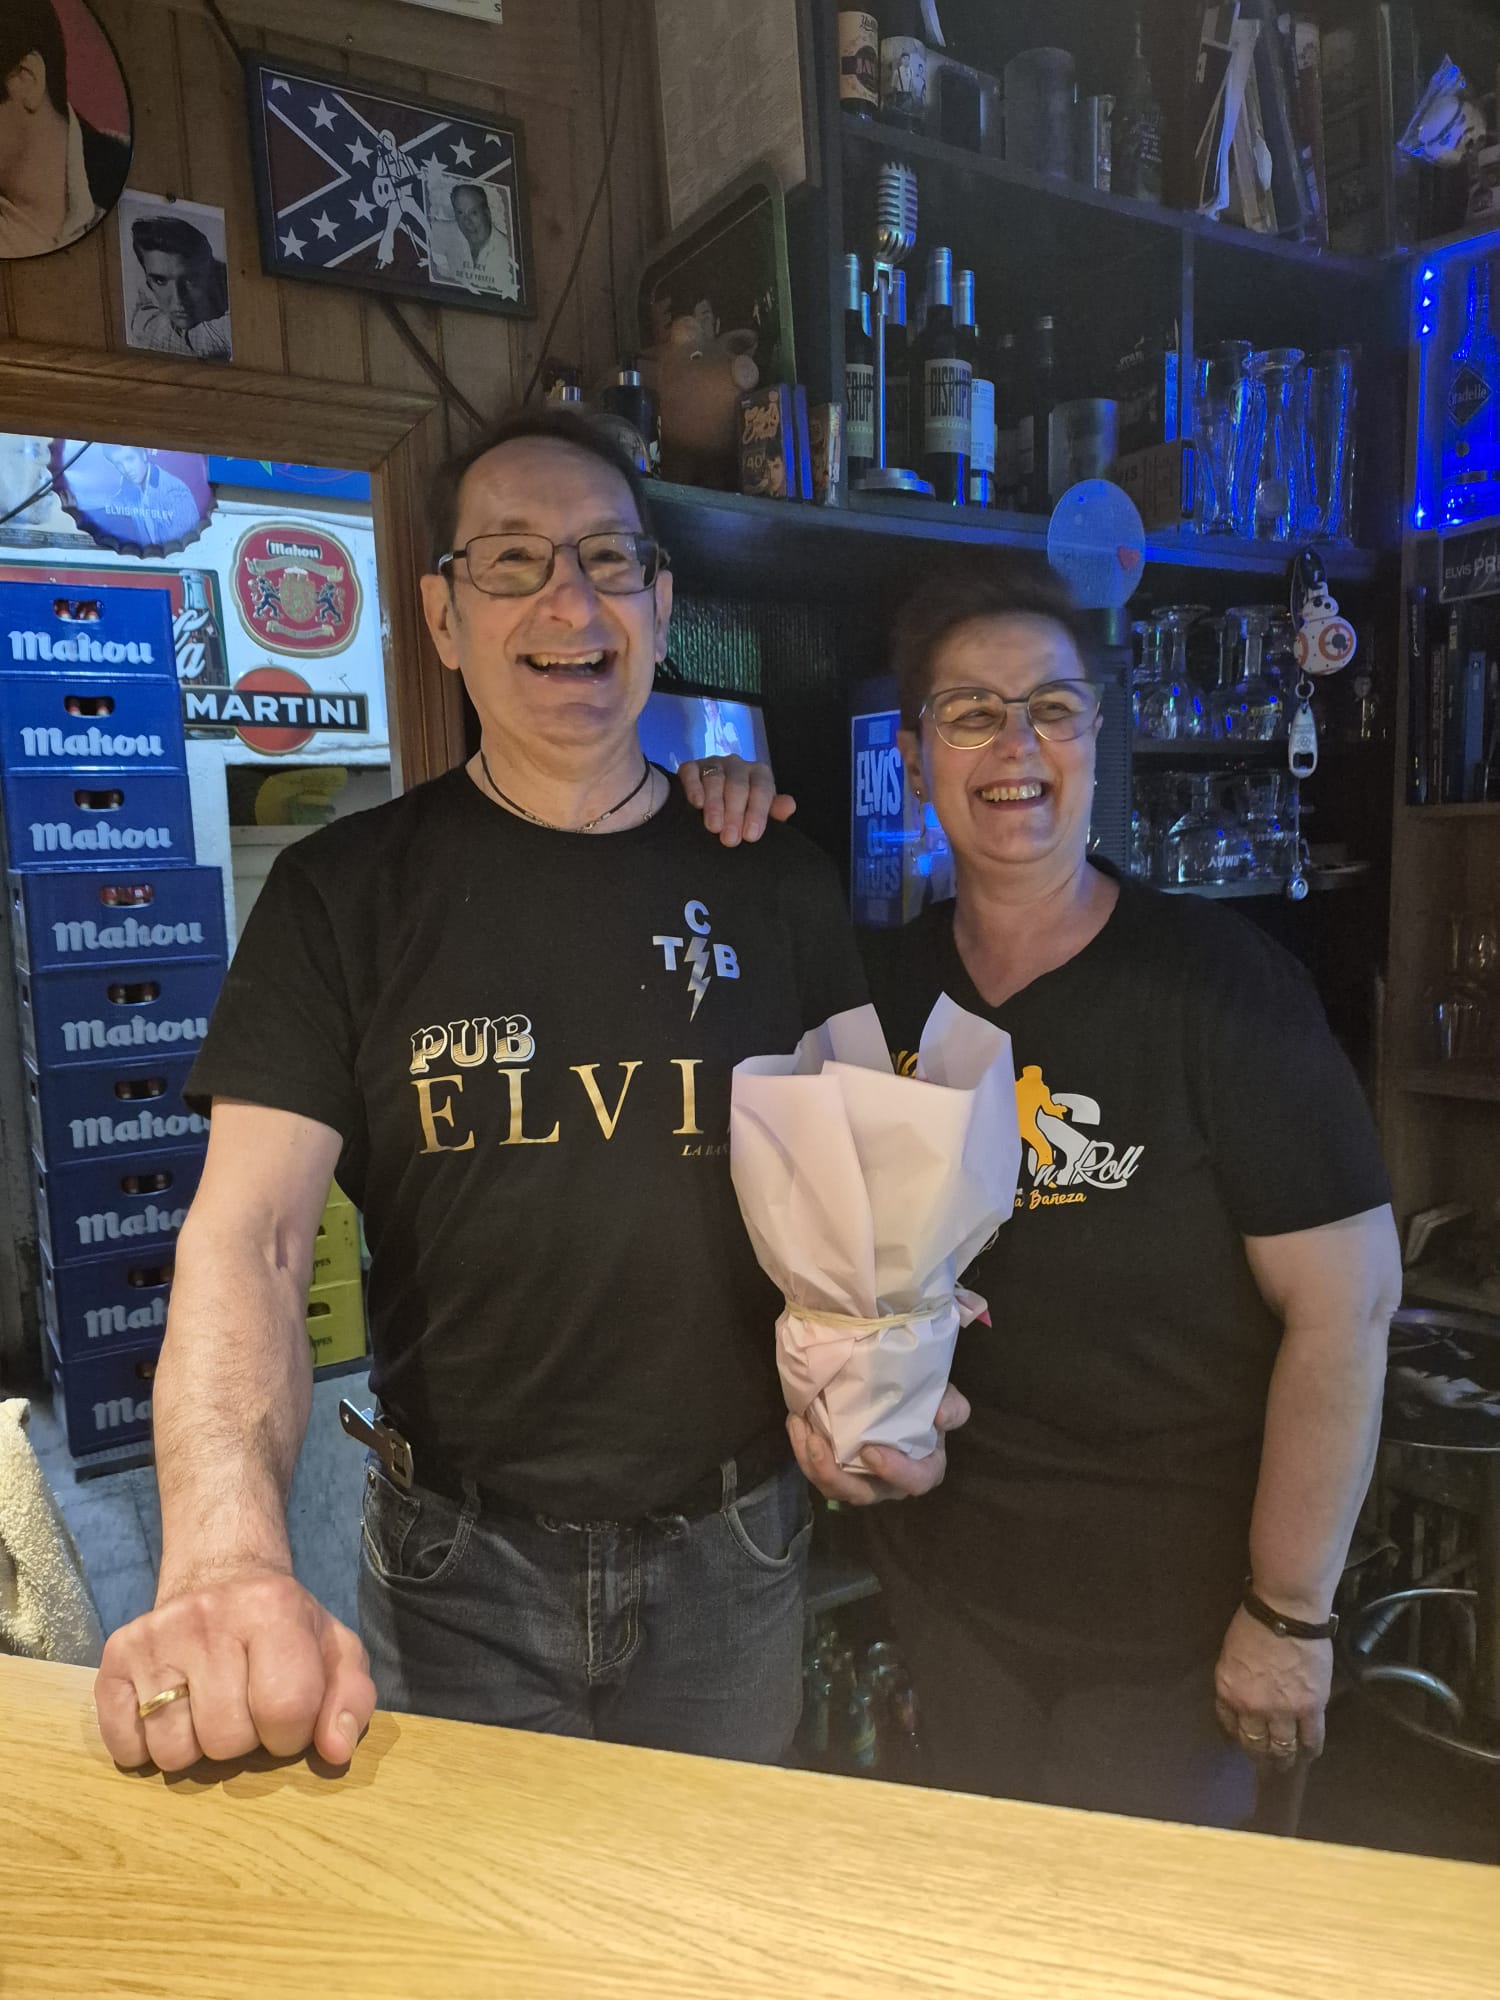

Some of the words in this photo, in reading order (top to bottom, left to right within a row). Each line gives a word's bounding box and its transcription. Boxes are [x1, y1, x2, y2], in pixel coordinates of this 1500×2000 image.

[104, 504, 131, 516] ELVIS
[132, 507, 174, 520] PRESLEY
[270, 541, 319, 558] Mahou
[8, 630, 155, 664] Mahou
[184, 691, 360, 726] MARTINI
[20, 726, 165, 757] Mahou
[856, 747, 901, 817] ELVIS
[28, 820, 173, 852] Mahou
[51, 917, 205, 952] Mahou
[61, 1014, 207, 1051] Mahou
[409, 1013, 536, 1075] PUB
[410, 1058, 705, 1154] ELVI
[1029, 1190, 1087, 1210] Bañeza
[76, 1205, 189, 1244] Maho
